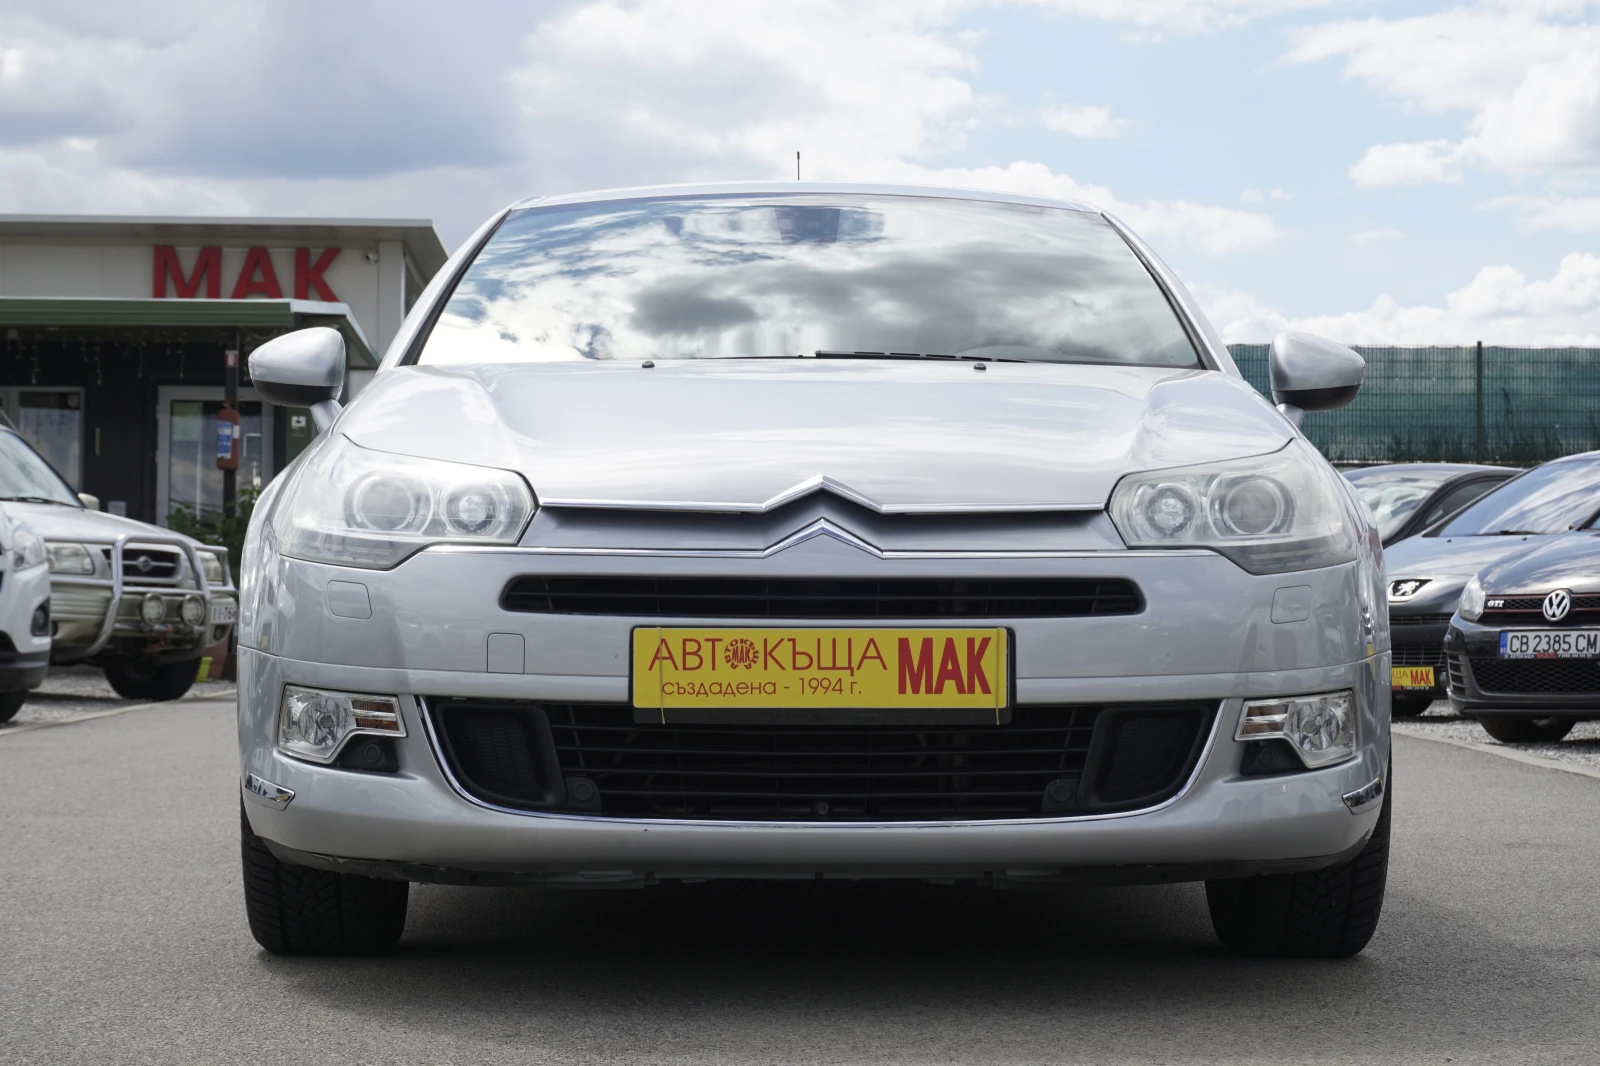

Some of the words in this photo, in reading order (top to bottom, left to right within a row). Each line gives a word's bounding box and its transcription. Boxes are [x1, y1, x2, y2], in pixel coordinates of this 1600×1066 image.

[153, 245, 342, 302] МАК
[1533, 634, 1572, 652] 2385
[898, 637, 992, 695] МАК
[661, 682, 777, 697] създадена
[799, 677, 843, 694] 1994
[1410, 669, 1432, 685] МАК
